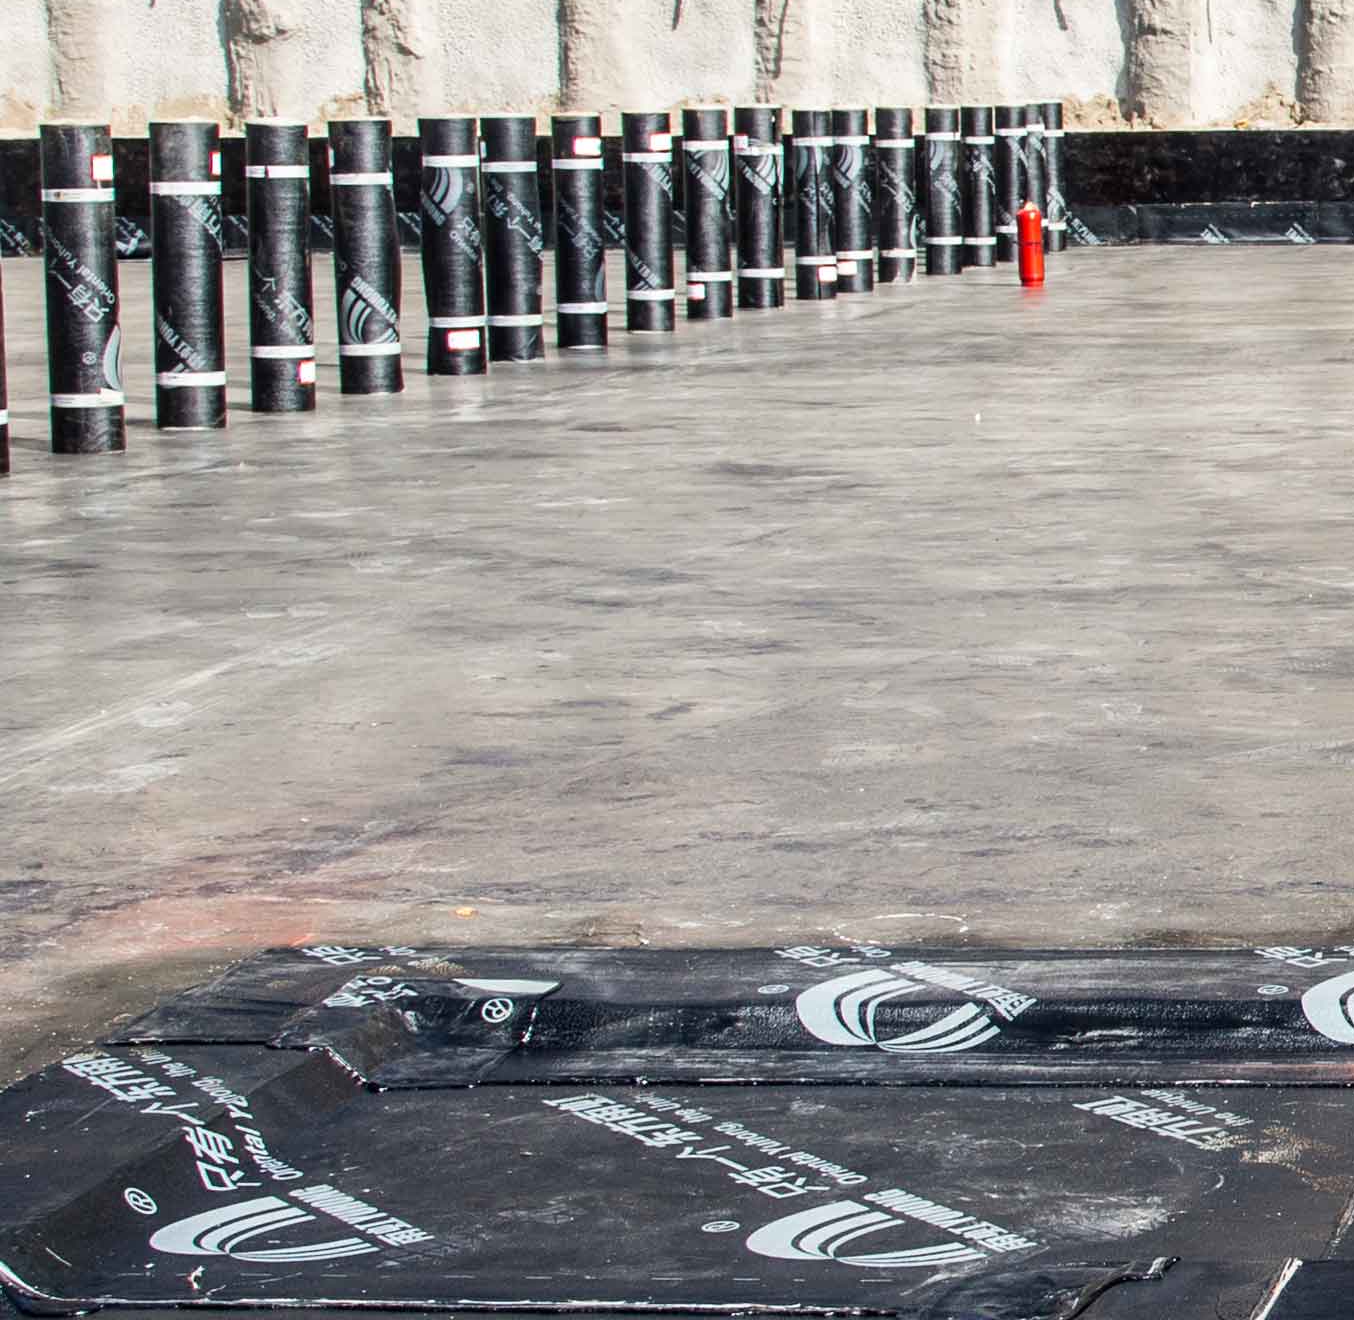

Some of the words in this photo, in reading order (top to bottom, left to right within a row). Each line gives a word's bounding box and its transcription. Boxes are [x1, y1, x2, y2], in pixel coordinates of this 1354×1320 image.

[234, 1124, 304, 1181] Oriental
[778, 1150, 868, 1186] Oriental
[287, 1183, 389, 1225] YUHONG
[863, 1188, 977, 1235] YUHONG
